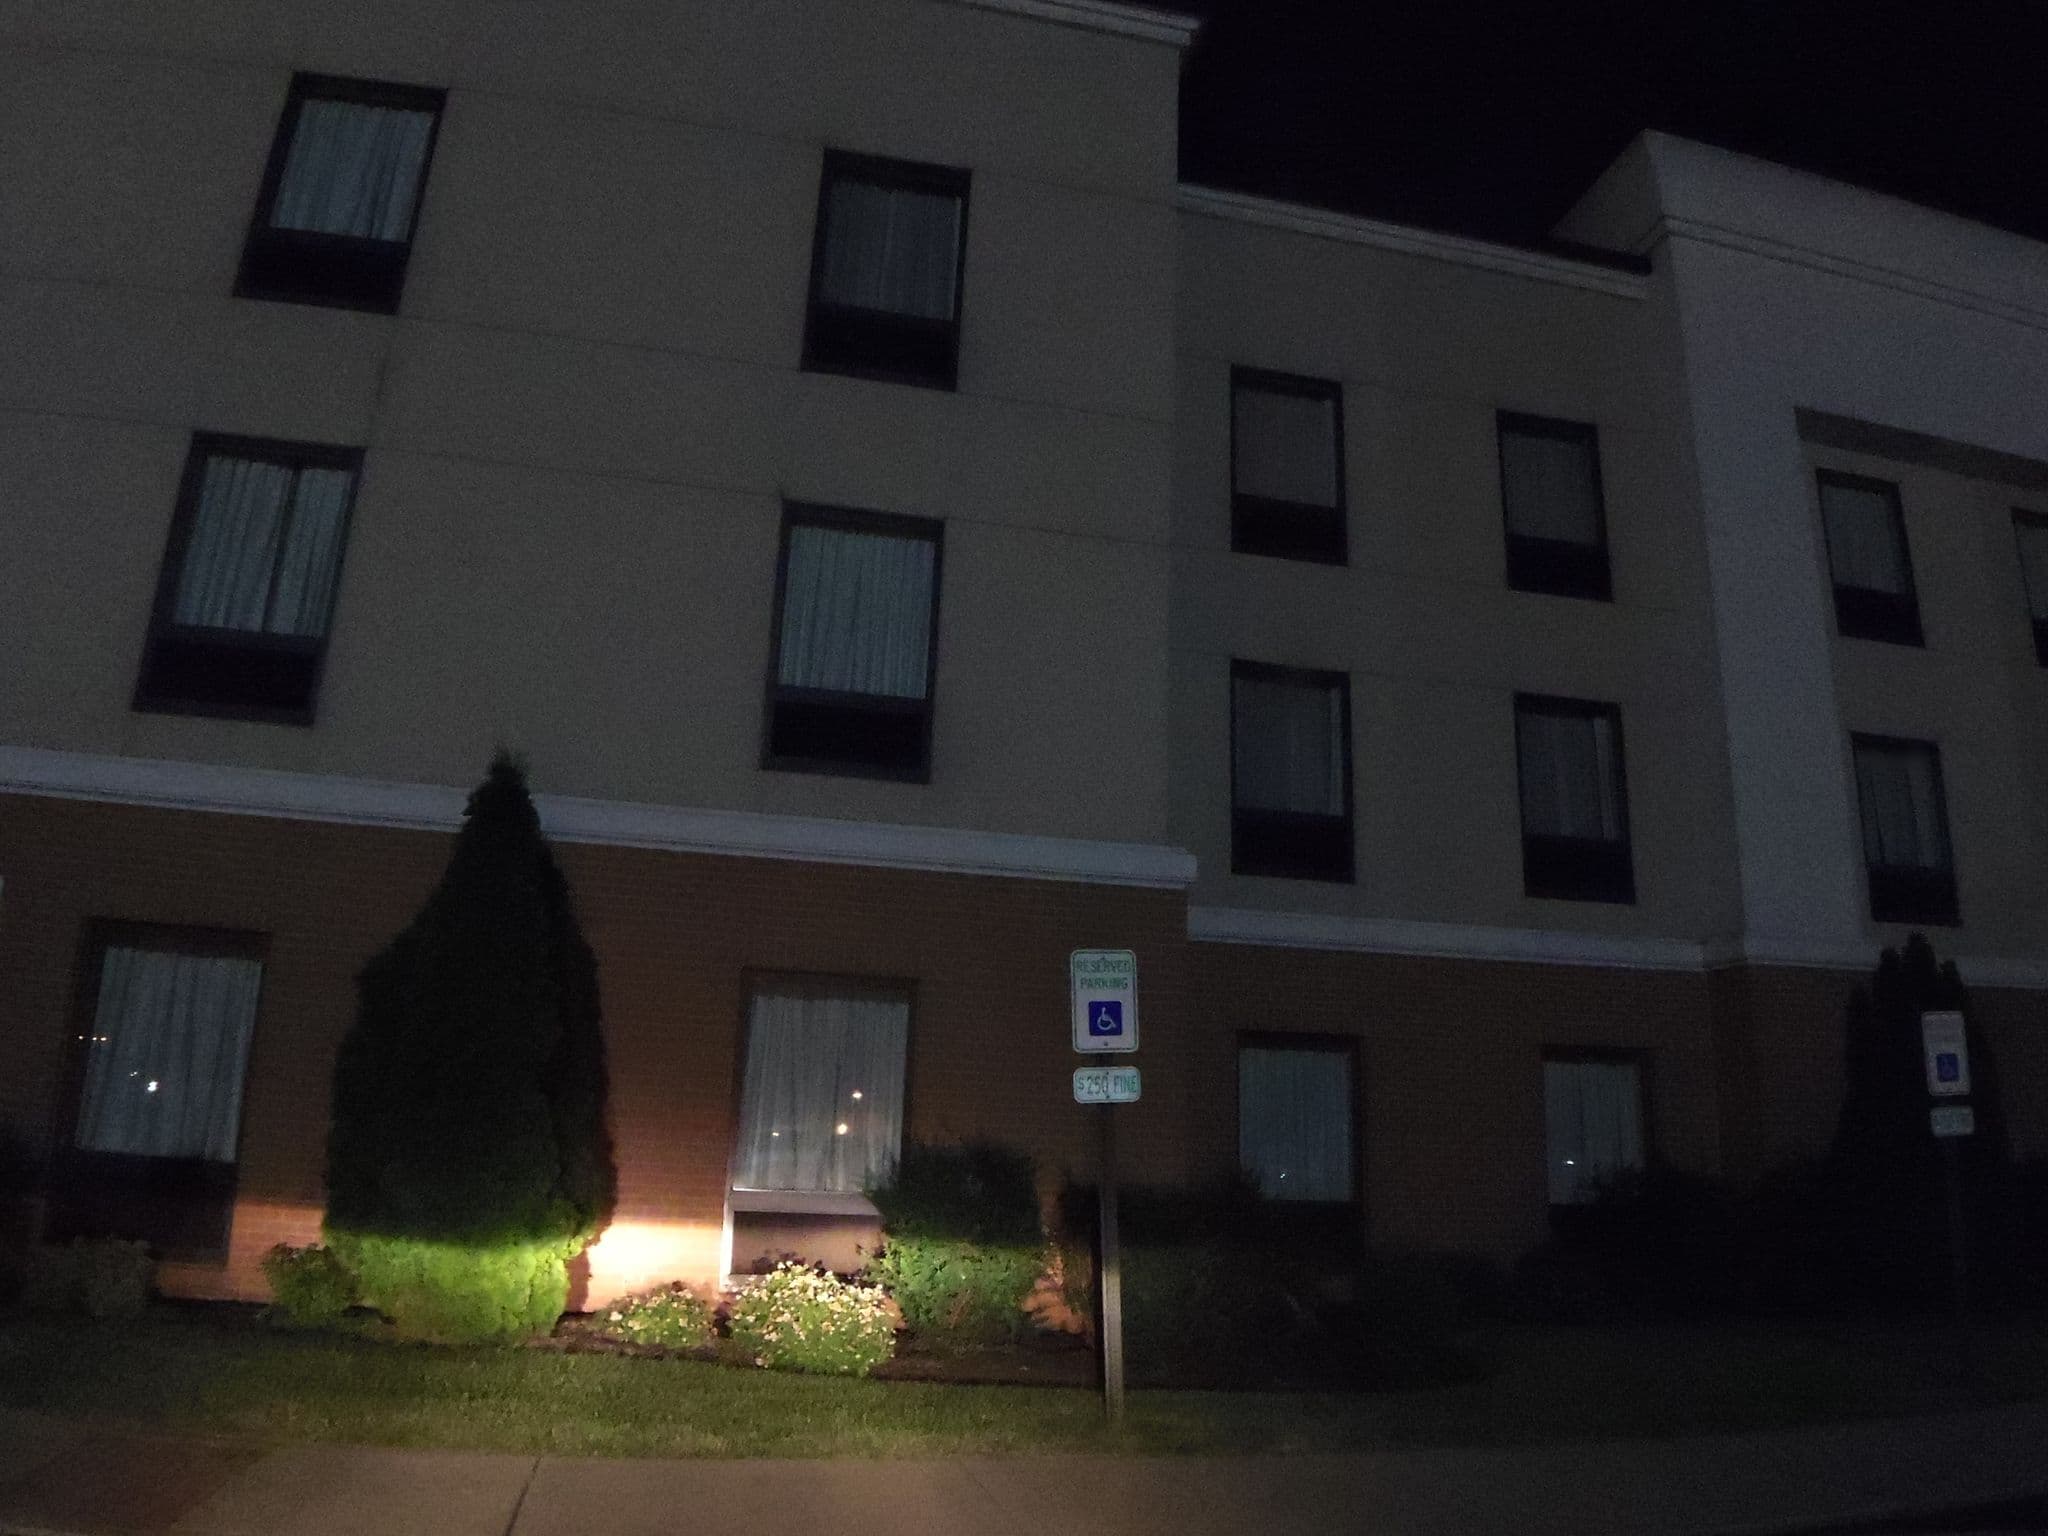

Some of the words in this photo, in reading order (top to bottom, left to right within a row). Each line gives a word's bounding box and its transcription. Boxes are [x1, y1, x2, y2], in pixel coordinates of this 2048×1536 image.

[1076, 959, 1131, 973] RESERVED
[1080, 976, 1129, 990] PARKING
[1077, 1074, 1109, 1095] $250
[1113, 1074, 1137, 1094] FINE
